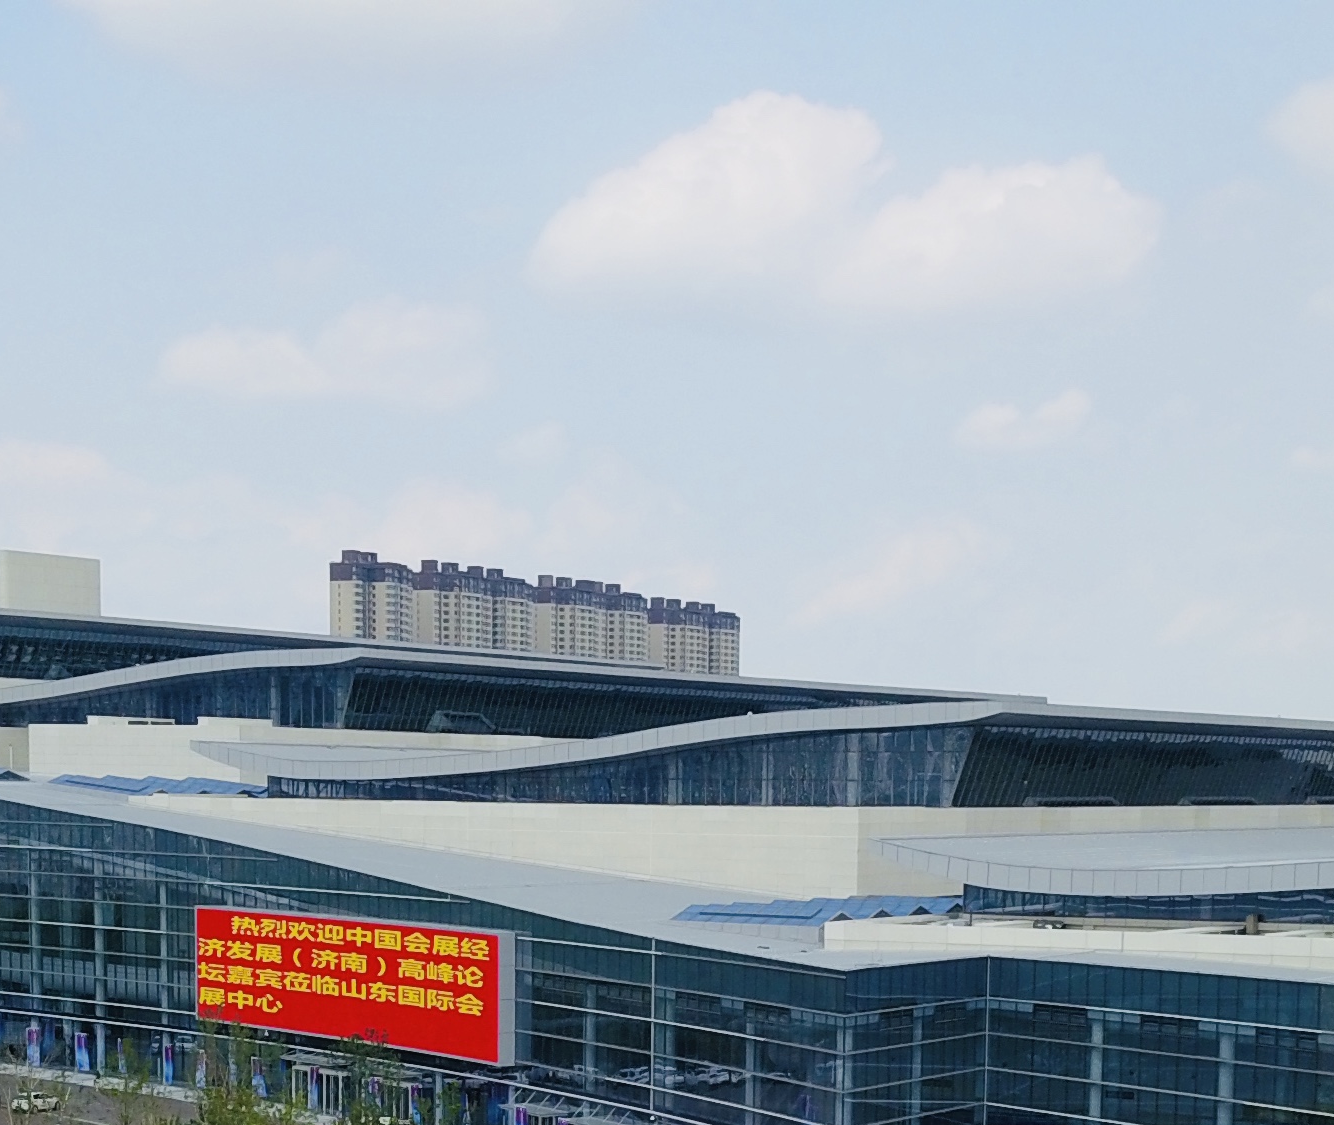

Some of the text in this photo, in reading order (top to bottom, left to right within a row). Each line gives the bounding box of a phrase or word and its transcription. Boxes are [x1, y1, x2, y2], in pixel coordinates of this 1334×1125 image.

[231, 915, 490, 961] 热烈欢迎中国会展经
[198, 938, 484, 988] 济发展（济南）高峰论
[198, 962, 484, 1016] 坛嘉宾莅临山东国际会
[198, 987, 283, 1013] 展中心
